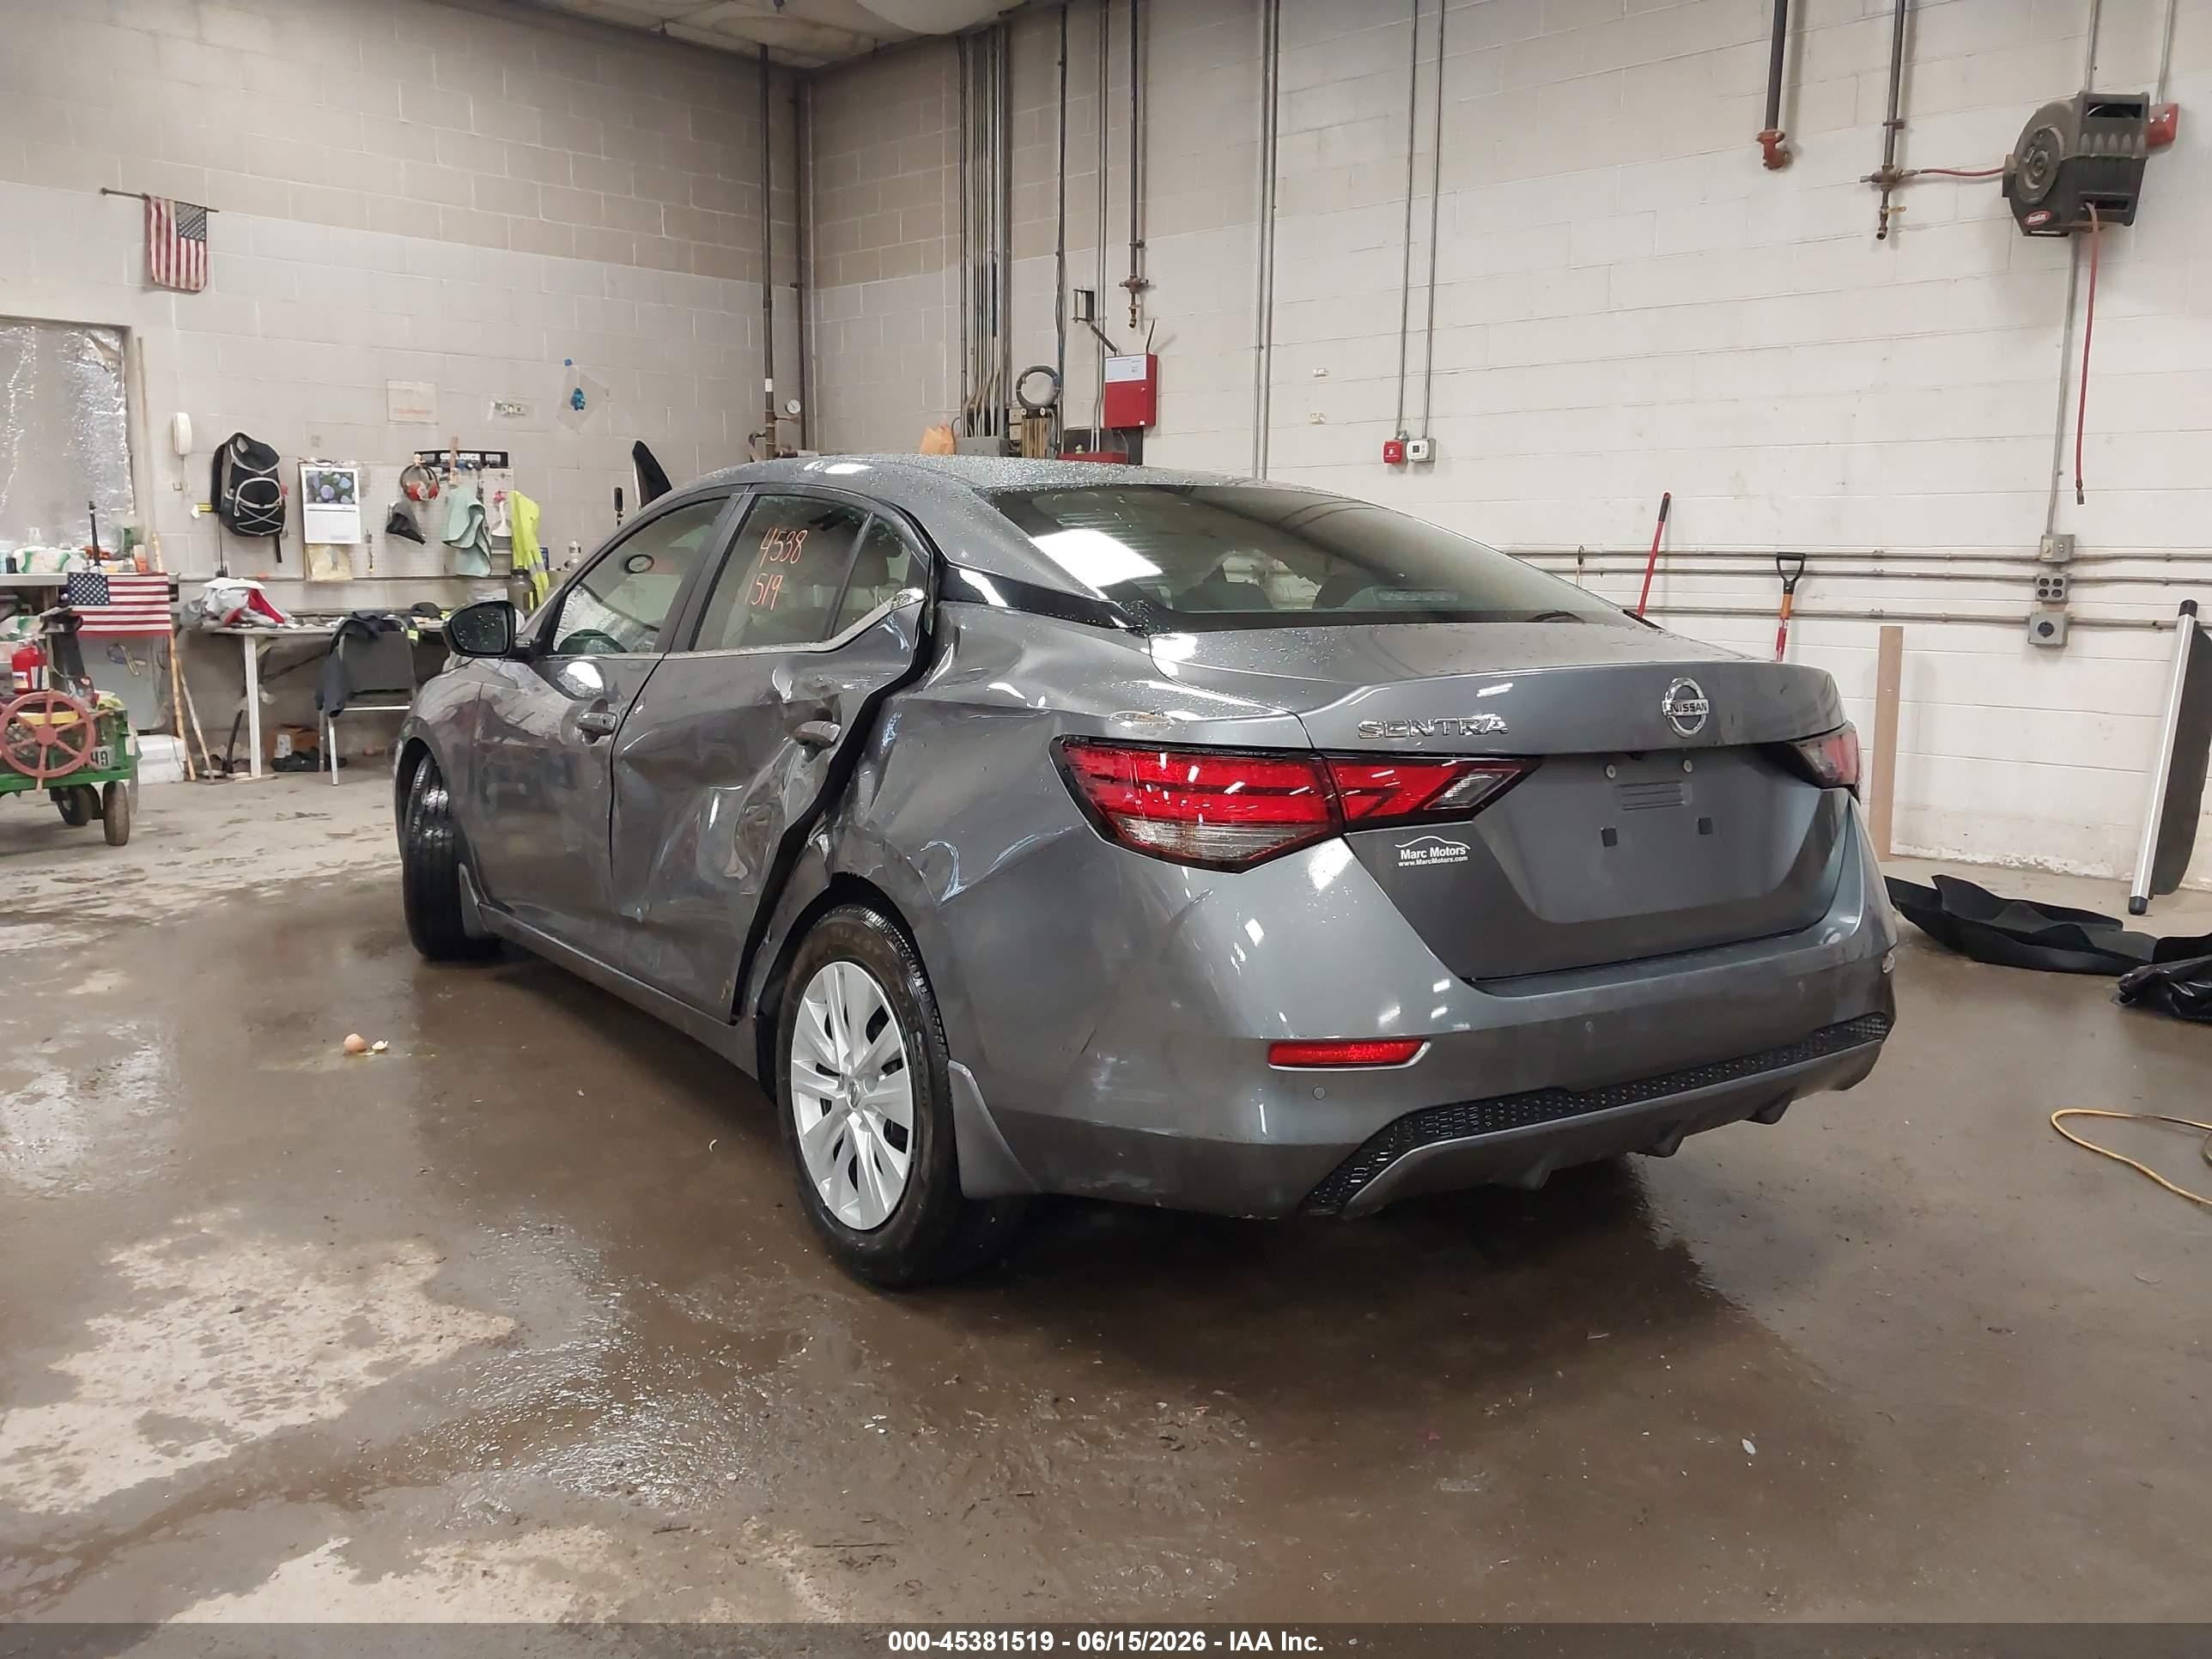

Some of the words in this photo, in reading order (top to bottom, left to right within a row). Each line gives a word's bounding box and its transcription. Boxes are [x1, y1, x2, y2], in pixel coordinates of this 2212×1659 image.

[759, 526, 808, 568] 4538
[1670, 702, 1707, 714] NISSAN
[1358, 713, 1509, 739] SENTRA
[1400, 848, 1427, 860] Marc
[1430, 846, 1467, 858] Motors
[1398, 855, 1468, 867] www.MarcMotors.com
